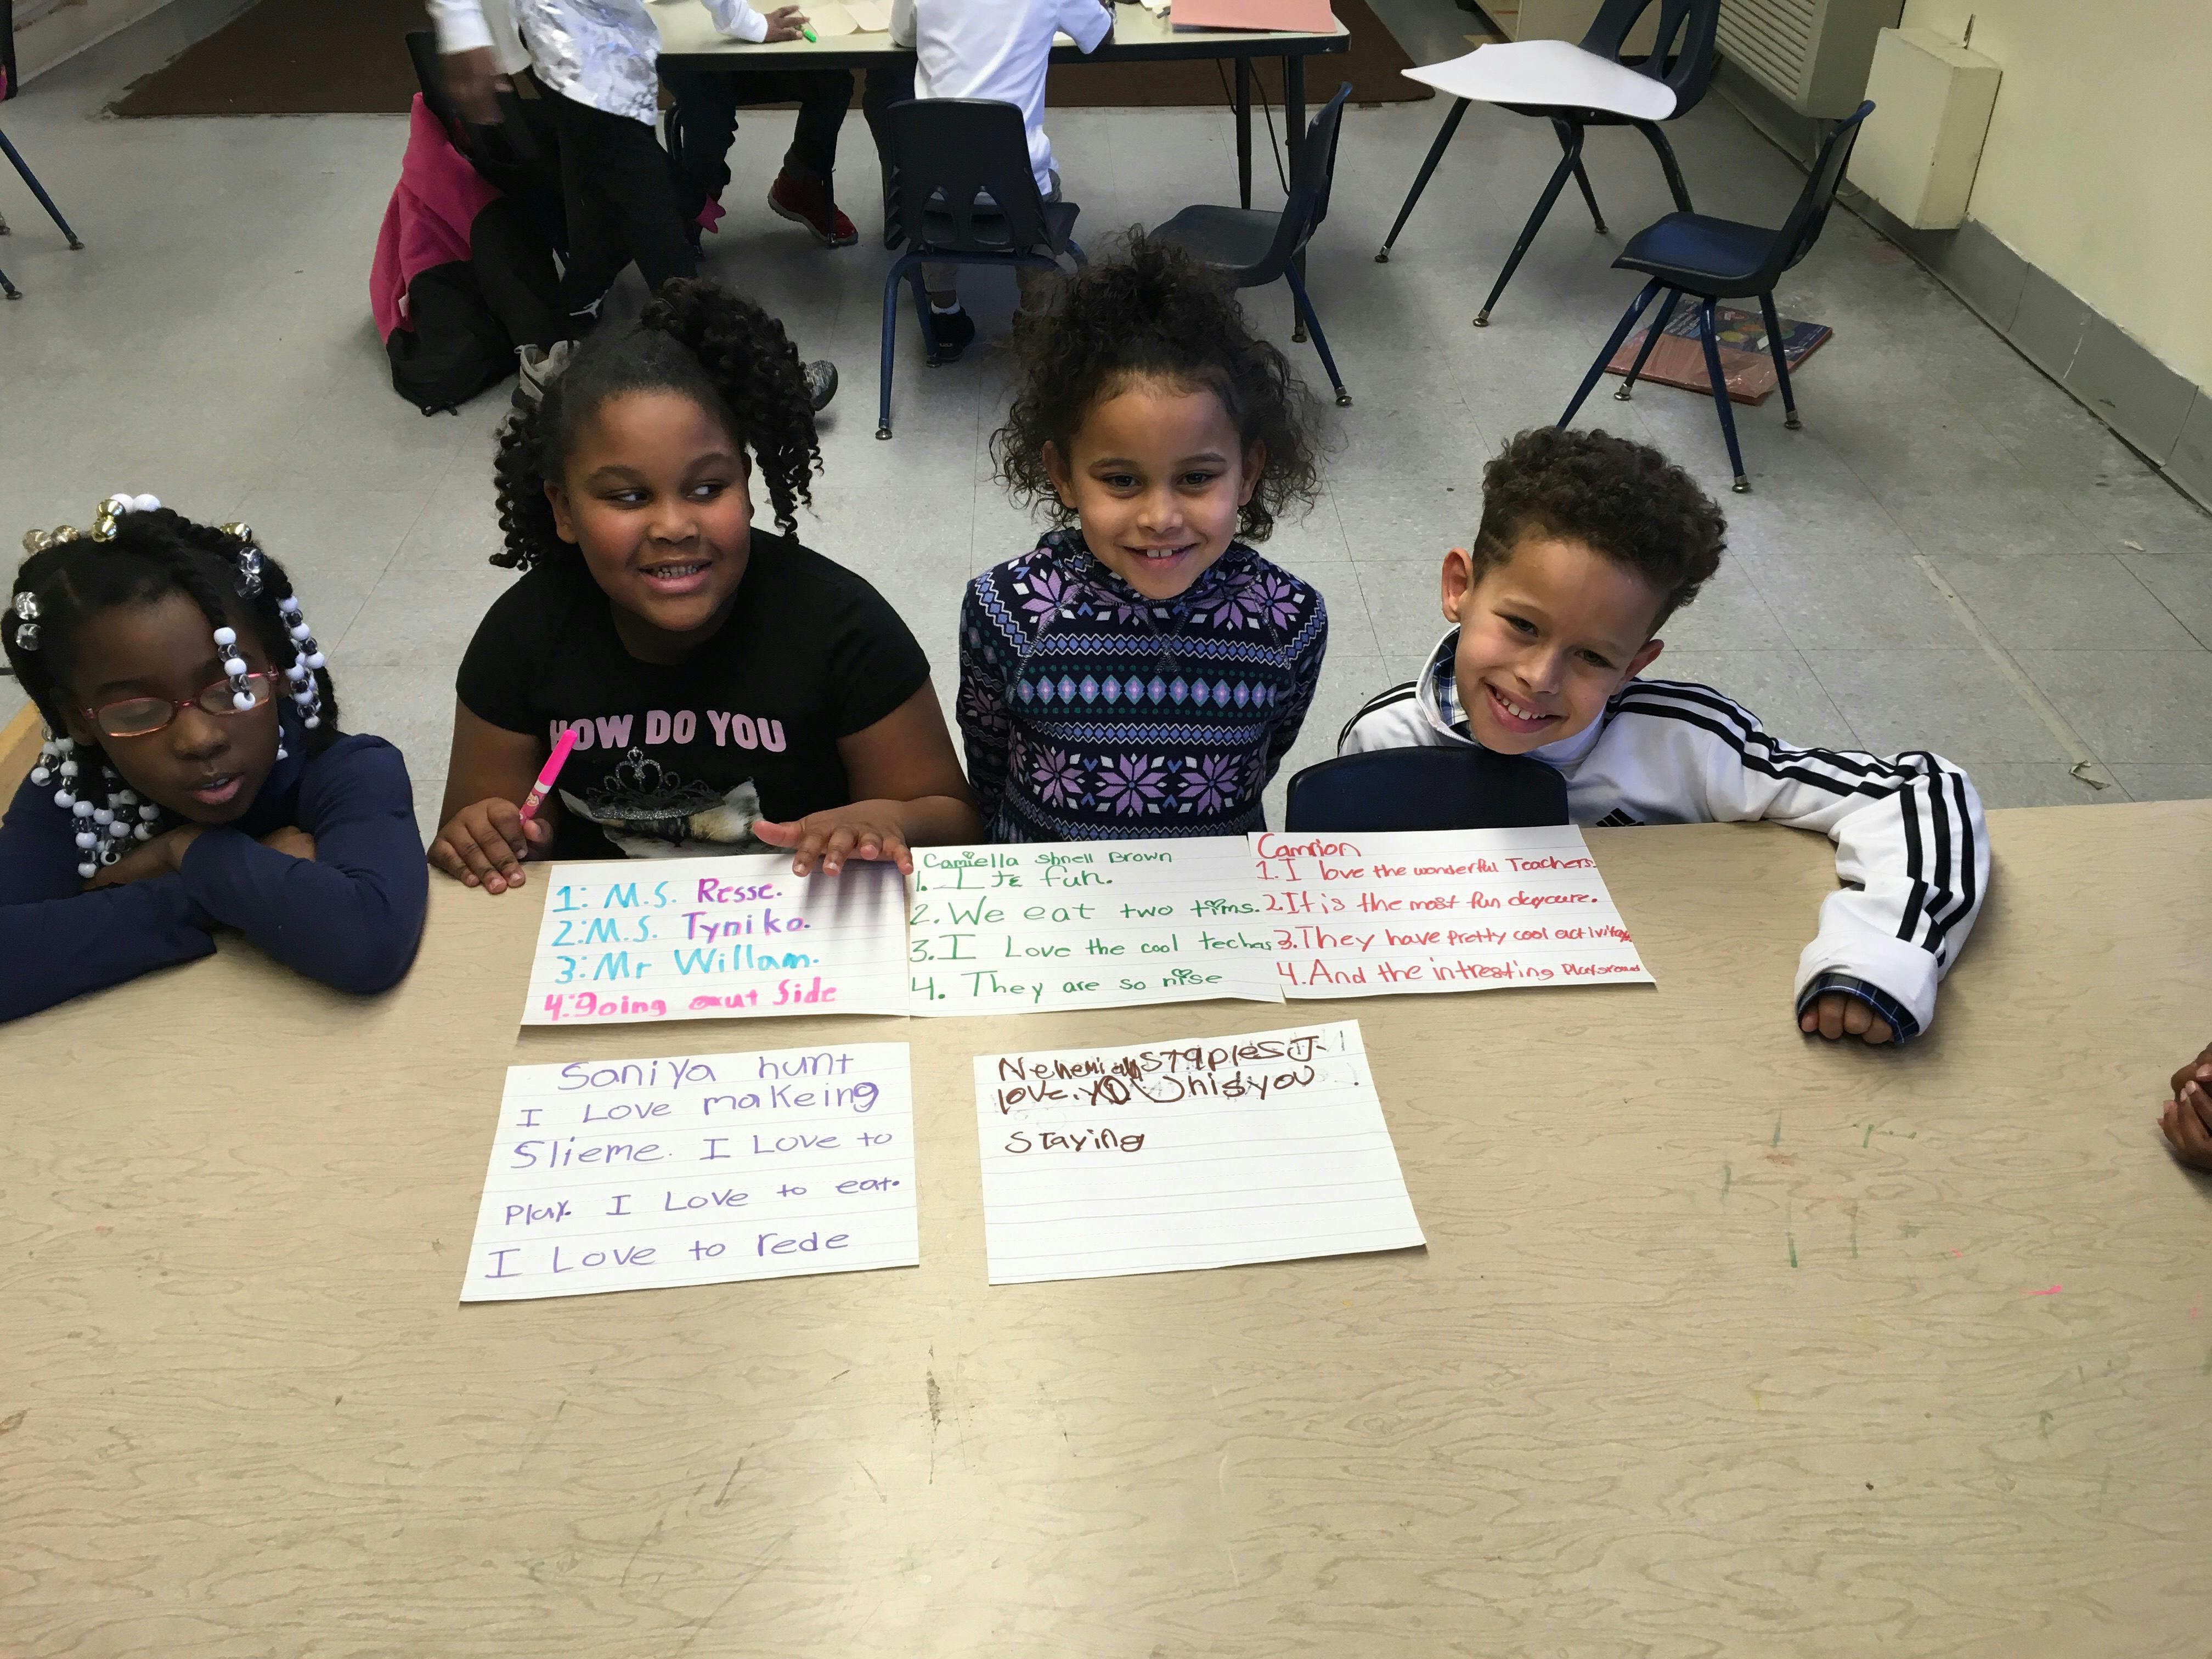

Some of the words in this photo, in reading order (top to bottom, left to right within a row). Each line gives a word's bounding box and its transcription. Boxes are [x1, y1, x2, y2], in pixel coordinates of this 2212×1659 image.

[550, 714, 634, 752] HOW
[645, 710, 696, 744] DO
[706, 710, 787, 753] YOU
[1278, 858, 1302, 882] I
[1318, 860, 1364, 881] love
[1373, 864, 1407, 878] the
[1414, 858, 1499, 876] wonderful
[947, 895, 1005, 925] We
[1023, 903, 1096, 922] eat
[1120, 903, 1173, 918] two
[1280, 891, 1316, 914] It
[1321, 893, 1345, 914] is
[1356, 891, 1402, 913] the
[1410, 895, 1460, 911] most
[1466, 891, 1500, 909] fun
[937, 934, 977, 960] I
[1006, 935, 1071, 958] Love
[1085, 938, 1125, 955] the
[1141, 933, 1178, 953] cool
[1295, 926, 1375, 952] They
[1387, 928, 1440, 946] have
[1513, 927, 1549, 940] cool
[593, 950, 652, 981] Mr
[1308, 959, 1367, 986] And
[1378, 961, 1423, 981] the
[960, 970, 1043, 1003] They
[1063, 979, 1101, 992] are
[1119, 978, 1146, 990] so
[516, 1108, 544, 1128] I
[698, 1137, 731, 1161] I
[856, 1130, 893, 1147] to
[606, 1194, 631, 1216] I
[776, 1182, 808, 1198] to
[484, 1248, 523, 1279] I
[689, 1238, 726, 1261] to
[757, 1231, 849, 1257] rede
